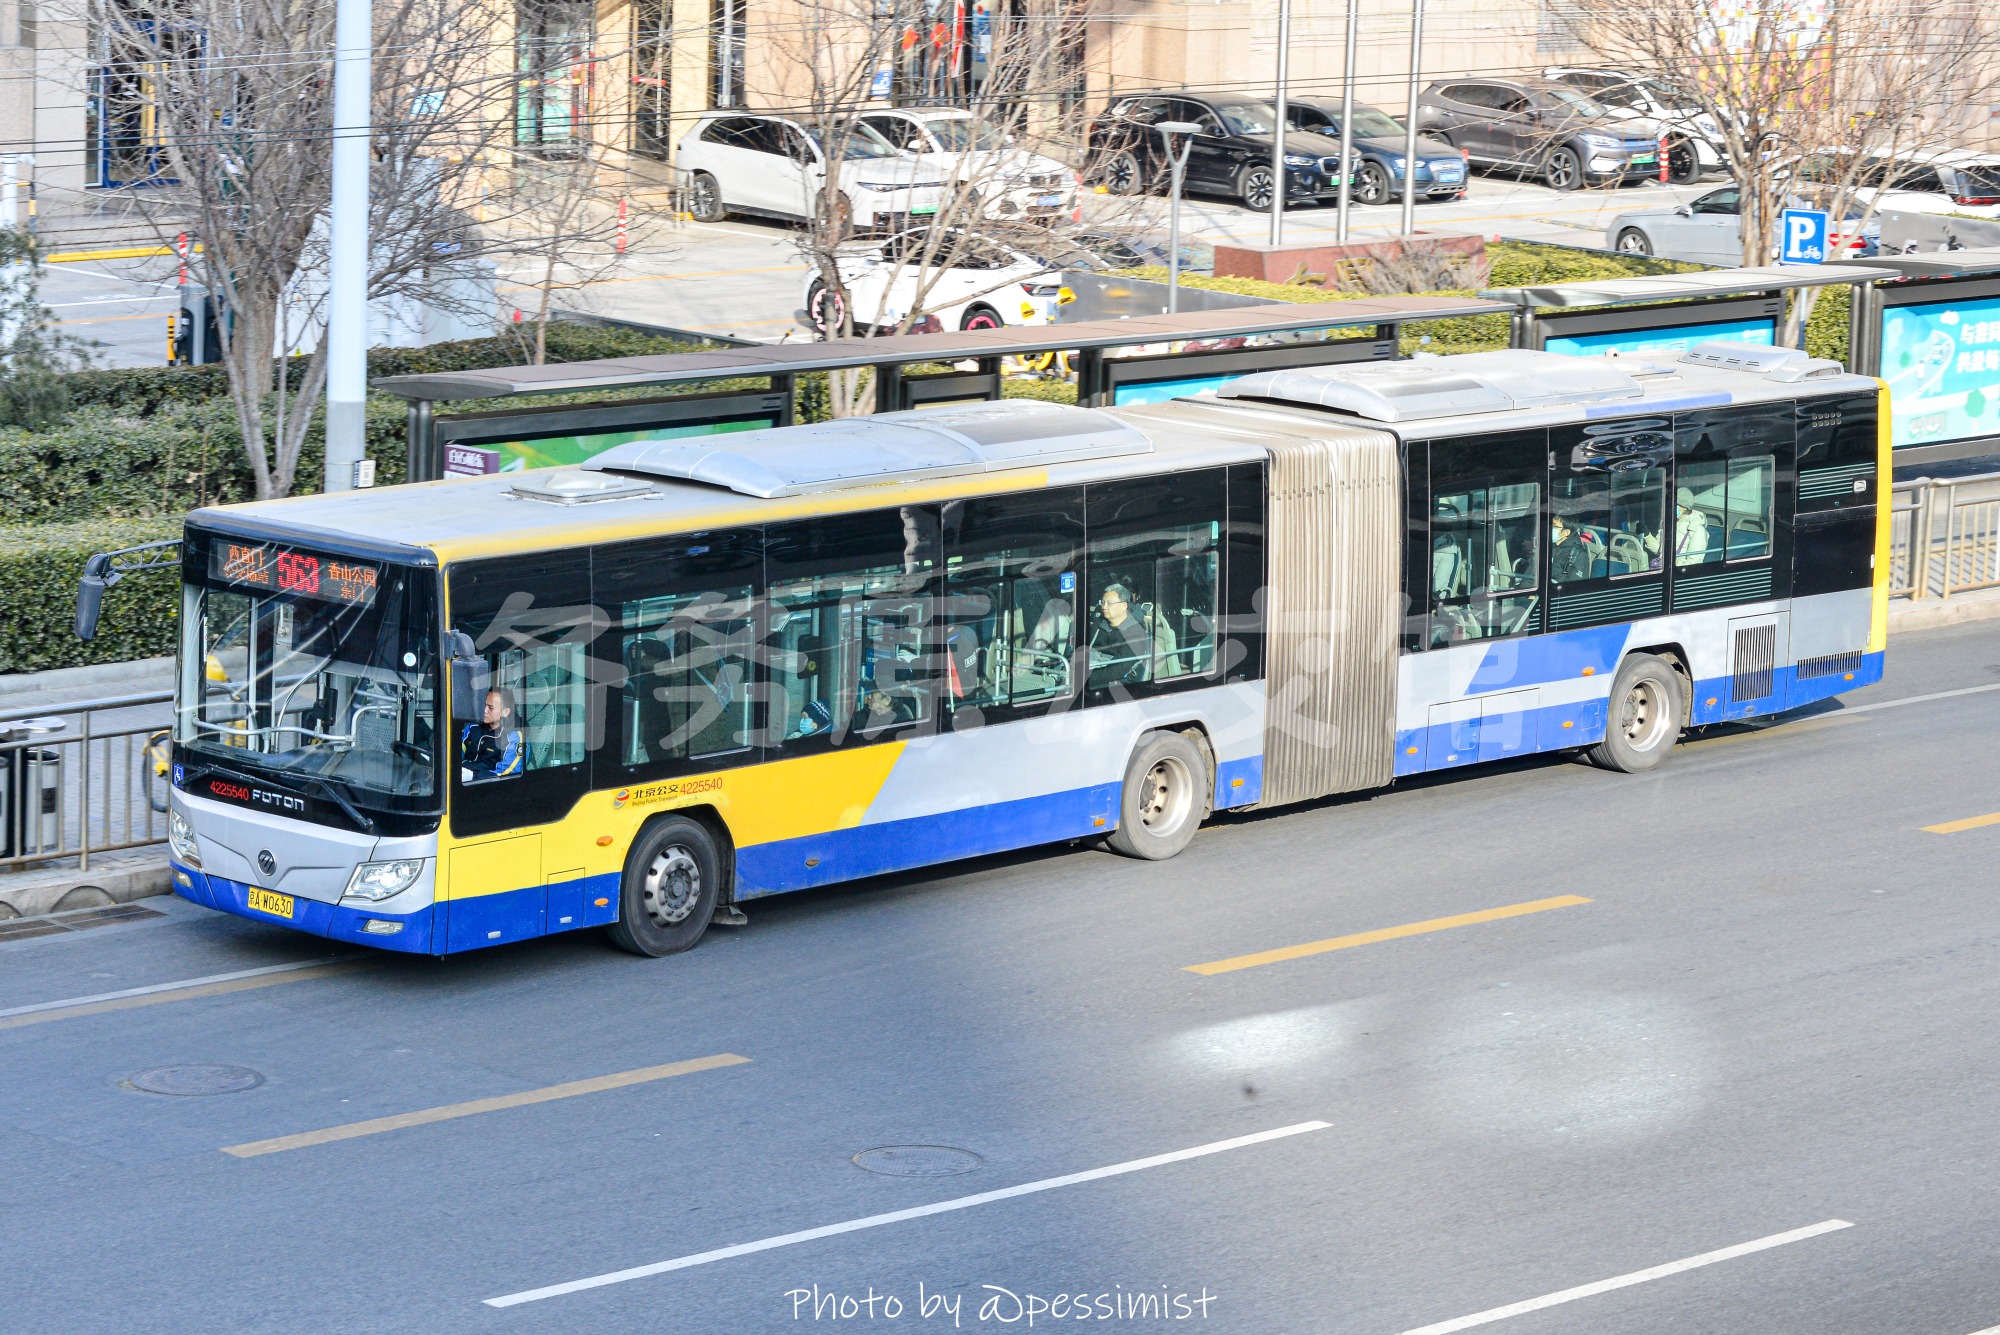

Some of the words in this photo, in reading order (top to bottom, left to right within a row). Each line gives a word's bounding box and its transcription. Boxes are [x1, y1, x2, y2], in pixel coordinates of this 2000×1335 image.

[1787, 216, 1816, 258] P
[228, 544, 263, 568] 西直门
[277, 551, 320, 594] 563
[328, 562, 377, 587] 香山公园
[341, 581, 365, 602] 东门
[209, 781, 250, 801] 4225540
[252, 789, 305, 811] FOTON
[633, 784, 679, 799] 北京公交
[680, 777, 723, 795] 4225540
[659, 795, 678, 803] Transport
